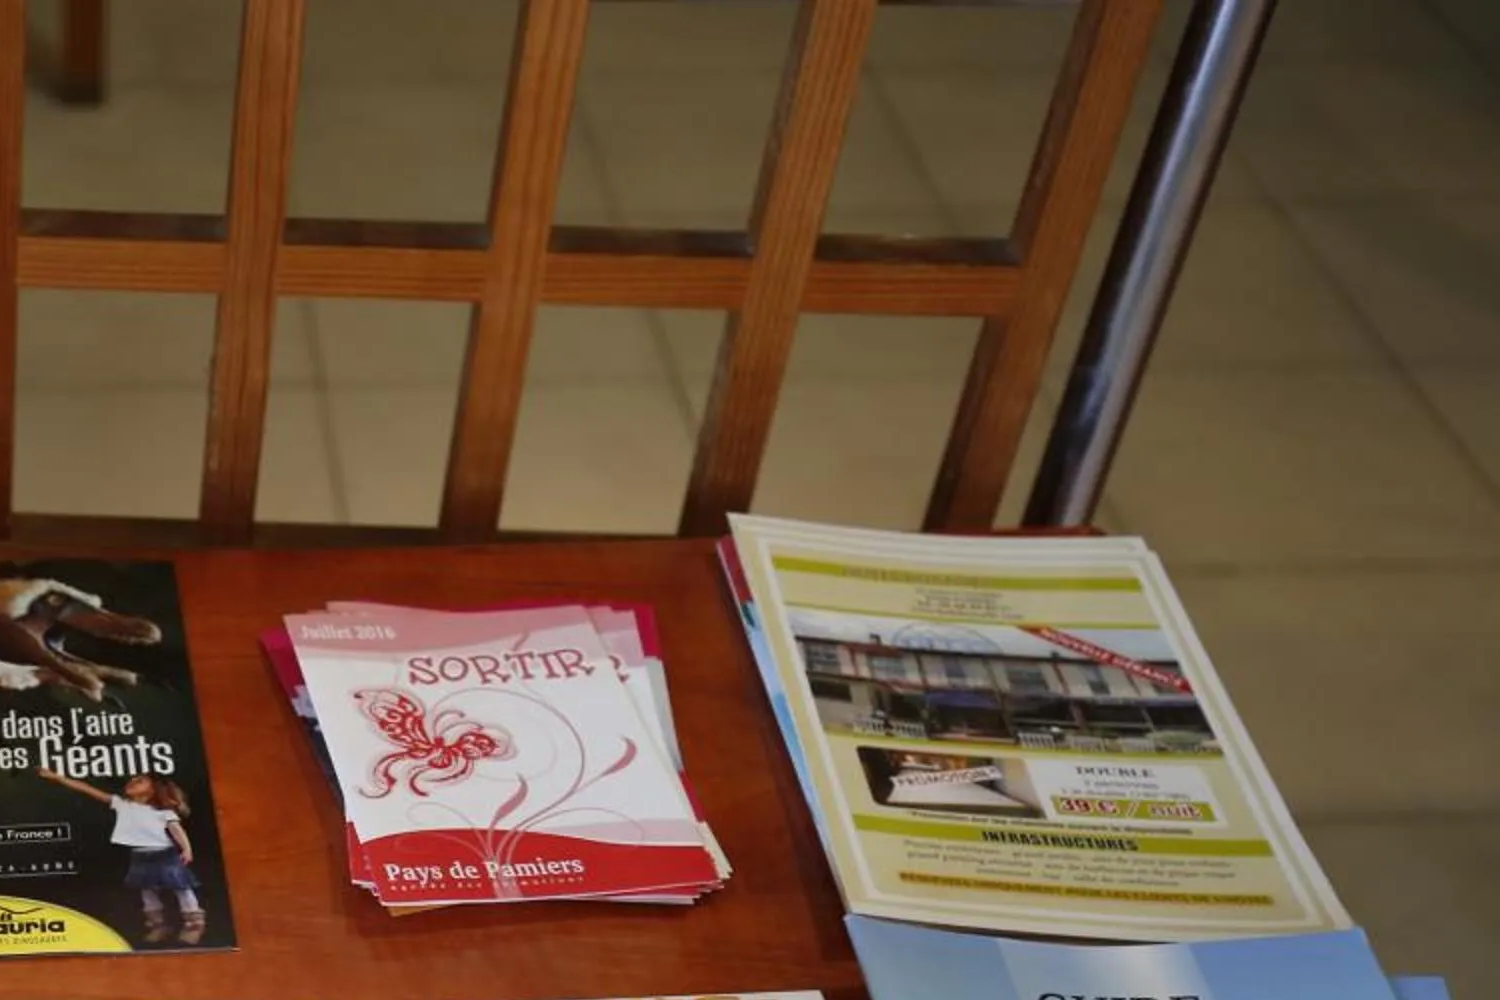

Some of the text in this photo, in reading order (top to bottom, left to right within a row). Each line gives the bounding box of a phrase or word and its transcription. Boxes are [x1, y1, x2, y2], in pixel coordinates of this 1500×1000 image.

[407, 648, 596, 685] SORTIR
[2, 709, 63, 740] dans
[70, 707, 134, 738] l'aire
[38, 733, 175, 780] Géants
[1059, 798, 1091, 814] 39
[1148, 802, 1203, 819] nuit
[6, 829, 53, 840] France
[384, 862, 444, 886] Pays
[449, 860, 481, 880] de
[482, 857, 585, 880] Pamiers
